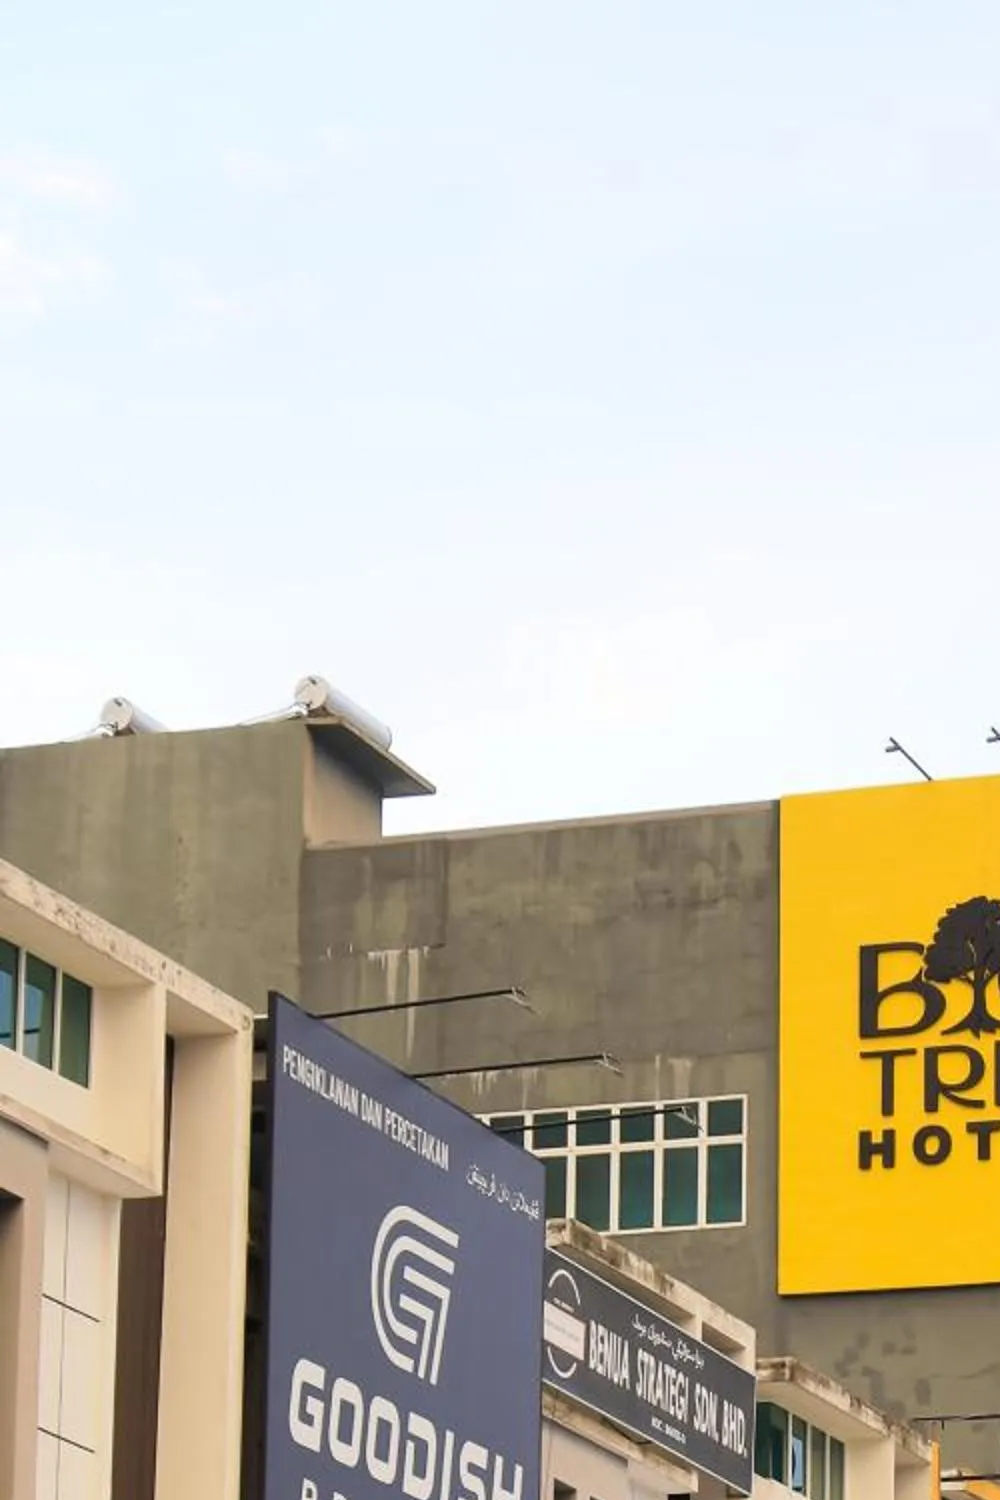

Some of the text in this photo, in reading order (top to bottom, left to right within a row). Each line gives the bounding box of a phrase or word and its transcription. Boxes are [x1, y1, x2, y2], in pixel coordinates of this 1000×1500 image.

[283, 1044, 449, 1172] PENGIKLANAN DAN PERCETAKAN
[635, 1347, 689, 1424] STRATEGI
[721, 1399, 748, 1458] BHD.
